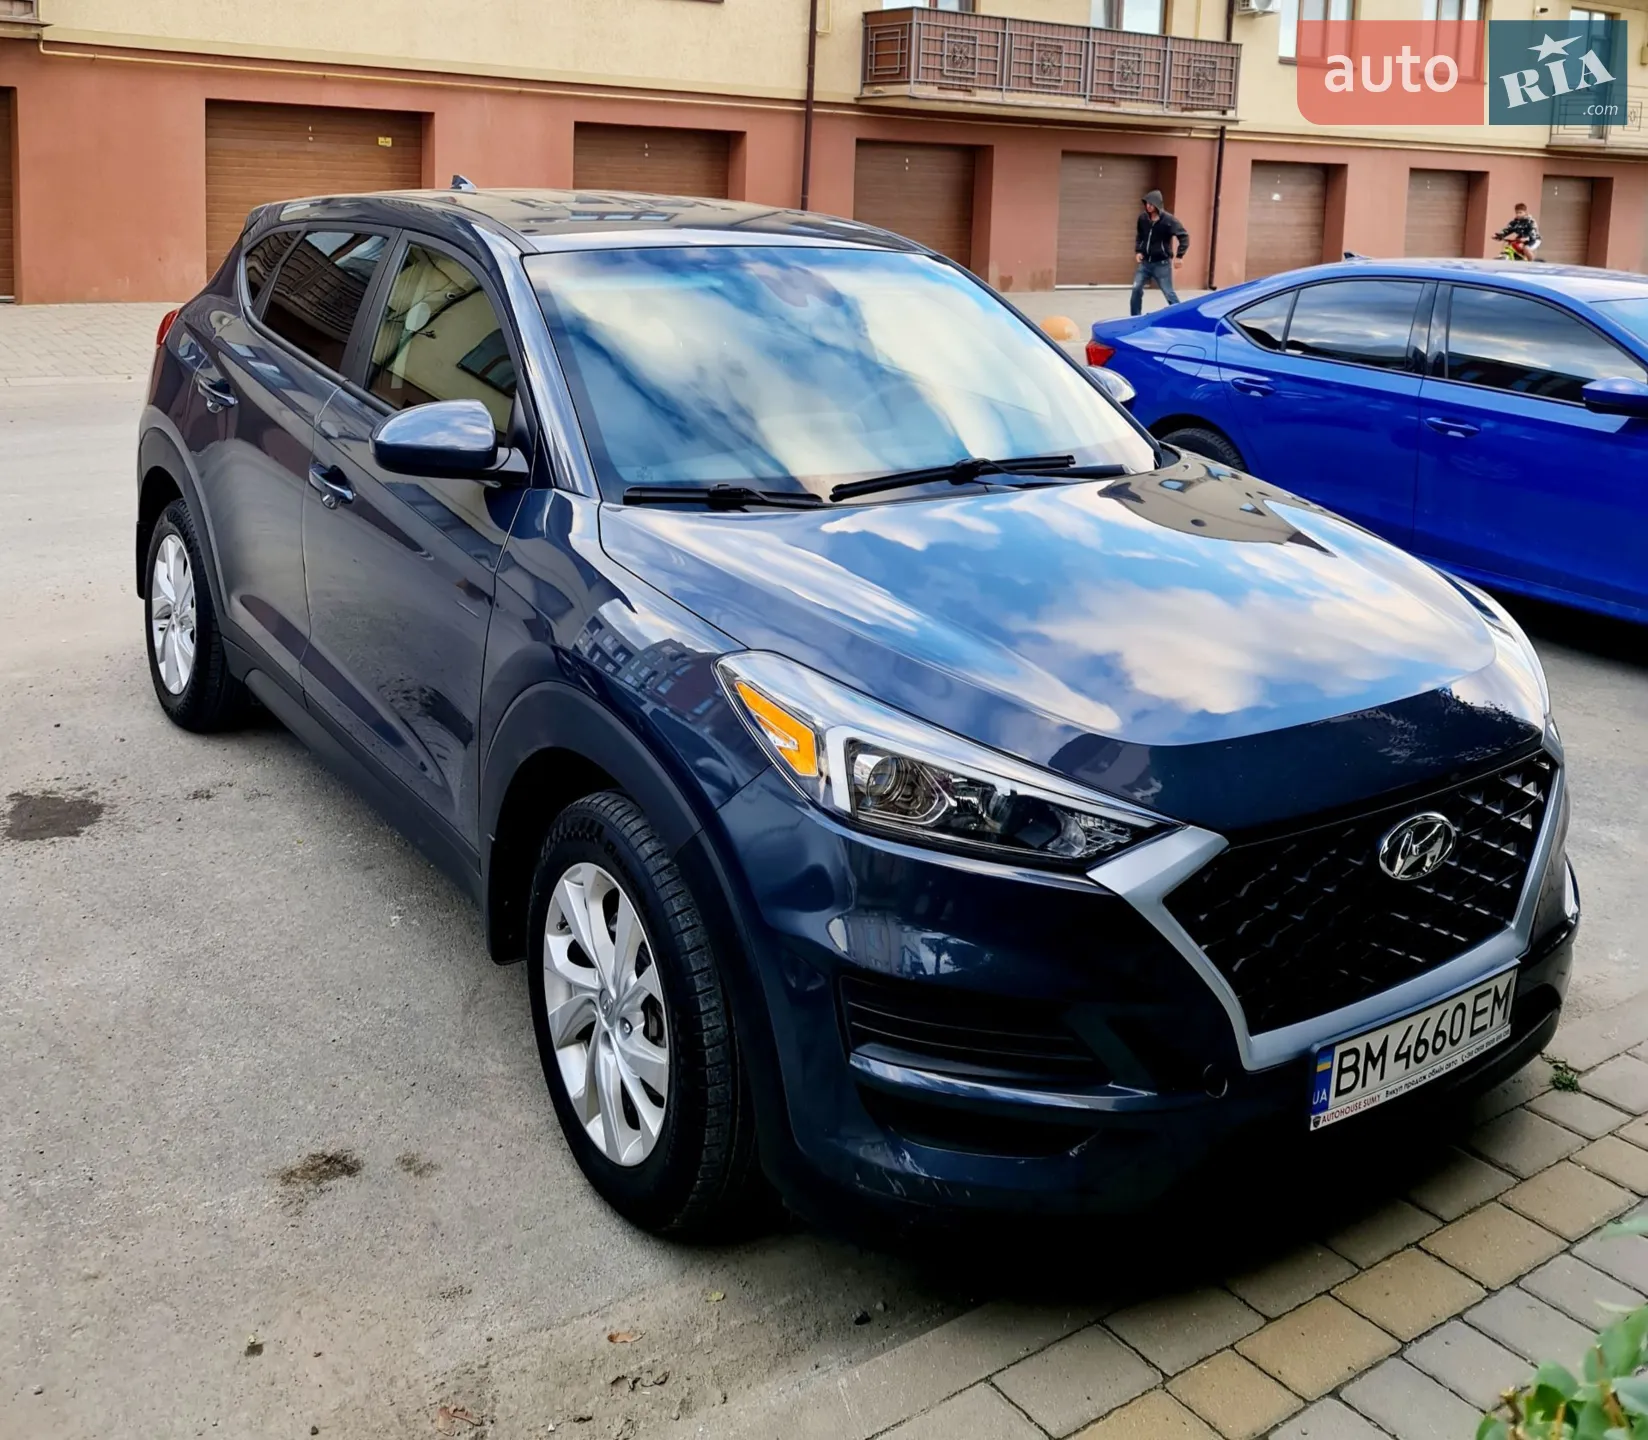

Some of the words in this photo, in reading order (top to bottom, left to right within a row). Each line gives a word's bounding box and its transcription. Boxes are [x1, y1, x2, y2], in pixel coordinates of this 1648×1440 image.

[1334, 1034, 1389, 1099] BM
[1394, 1002, 1466, 1070] 4660
[1469, 977, 1512, 1039] EM
[1312, 1088, 1327, 1105] UA
[1321, 1101, 1362, 1124] AUTOHOUSE
[1363, 1094, 1381, 1112] SUMY
